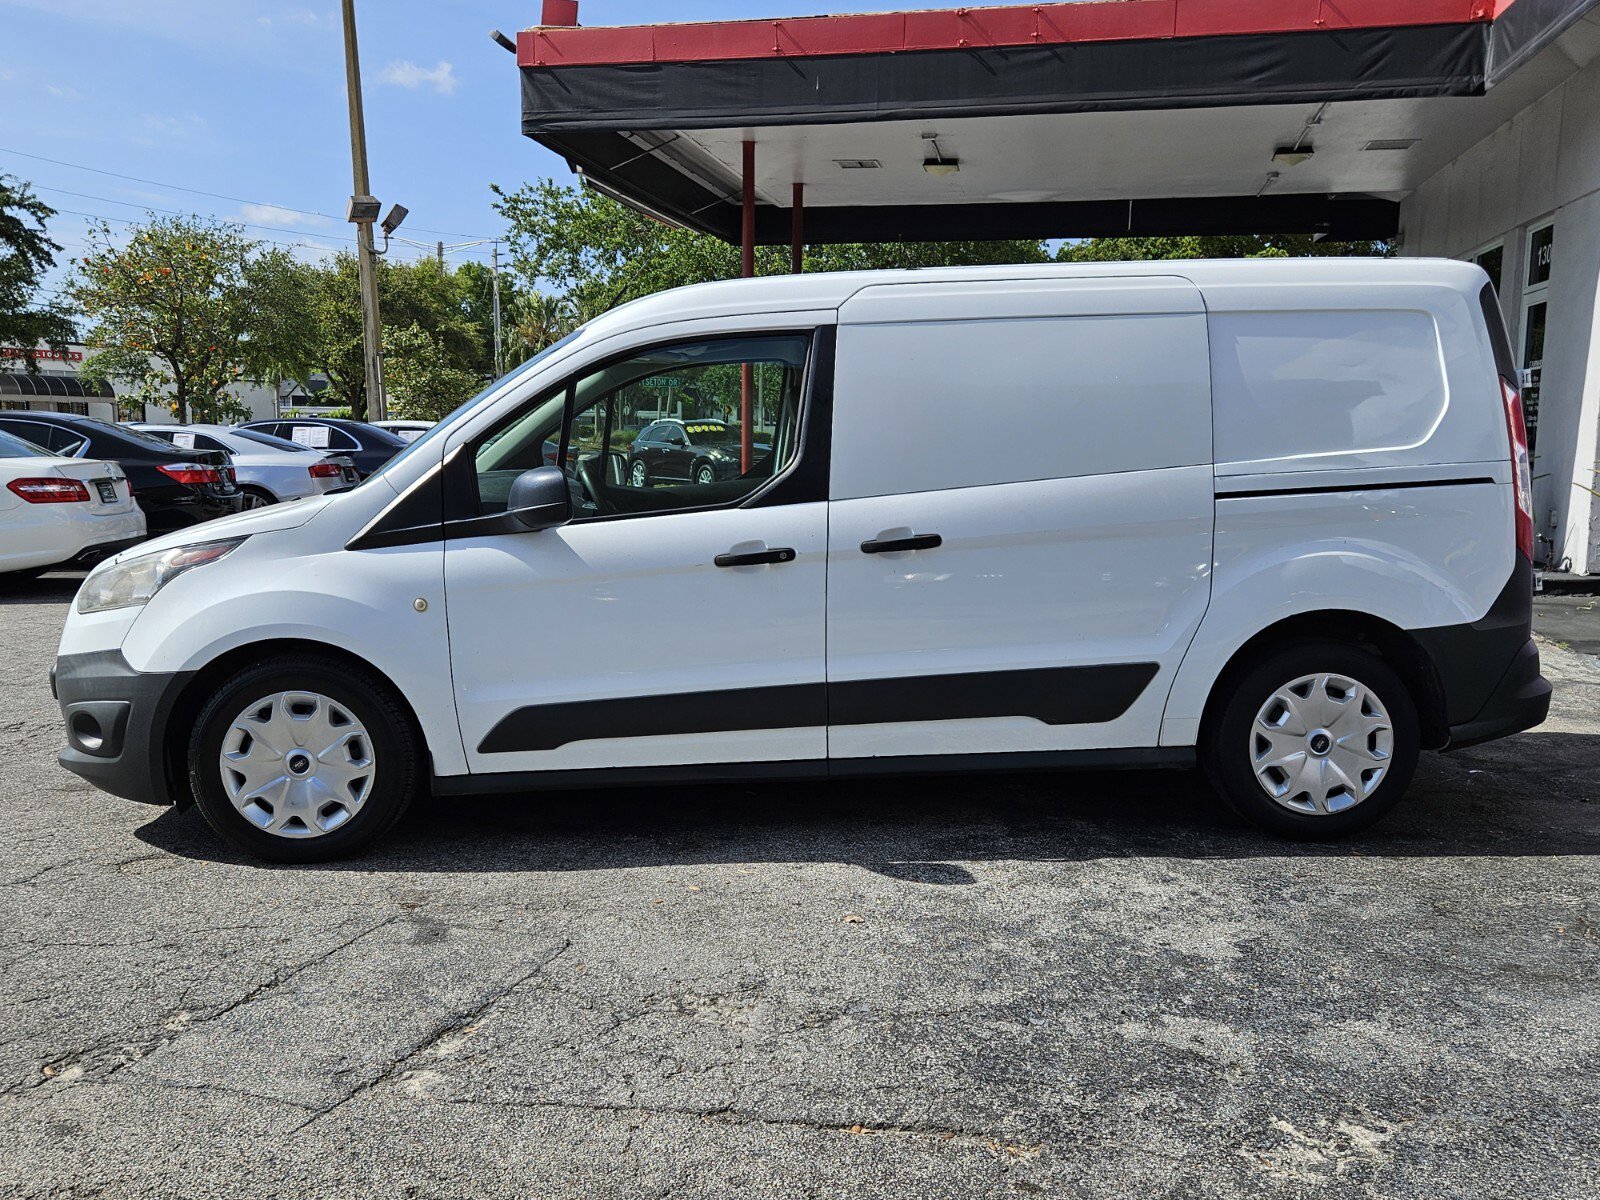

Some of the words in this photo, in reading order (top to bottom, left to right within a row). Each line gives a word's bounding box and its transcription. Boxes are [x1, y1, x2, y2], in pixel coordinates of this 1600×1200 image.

[36, 351, 79, 359] LIQURS
[645, 378, 666, 386] SETON
[669, 379, 678, 387] DR
